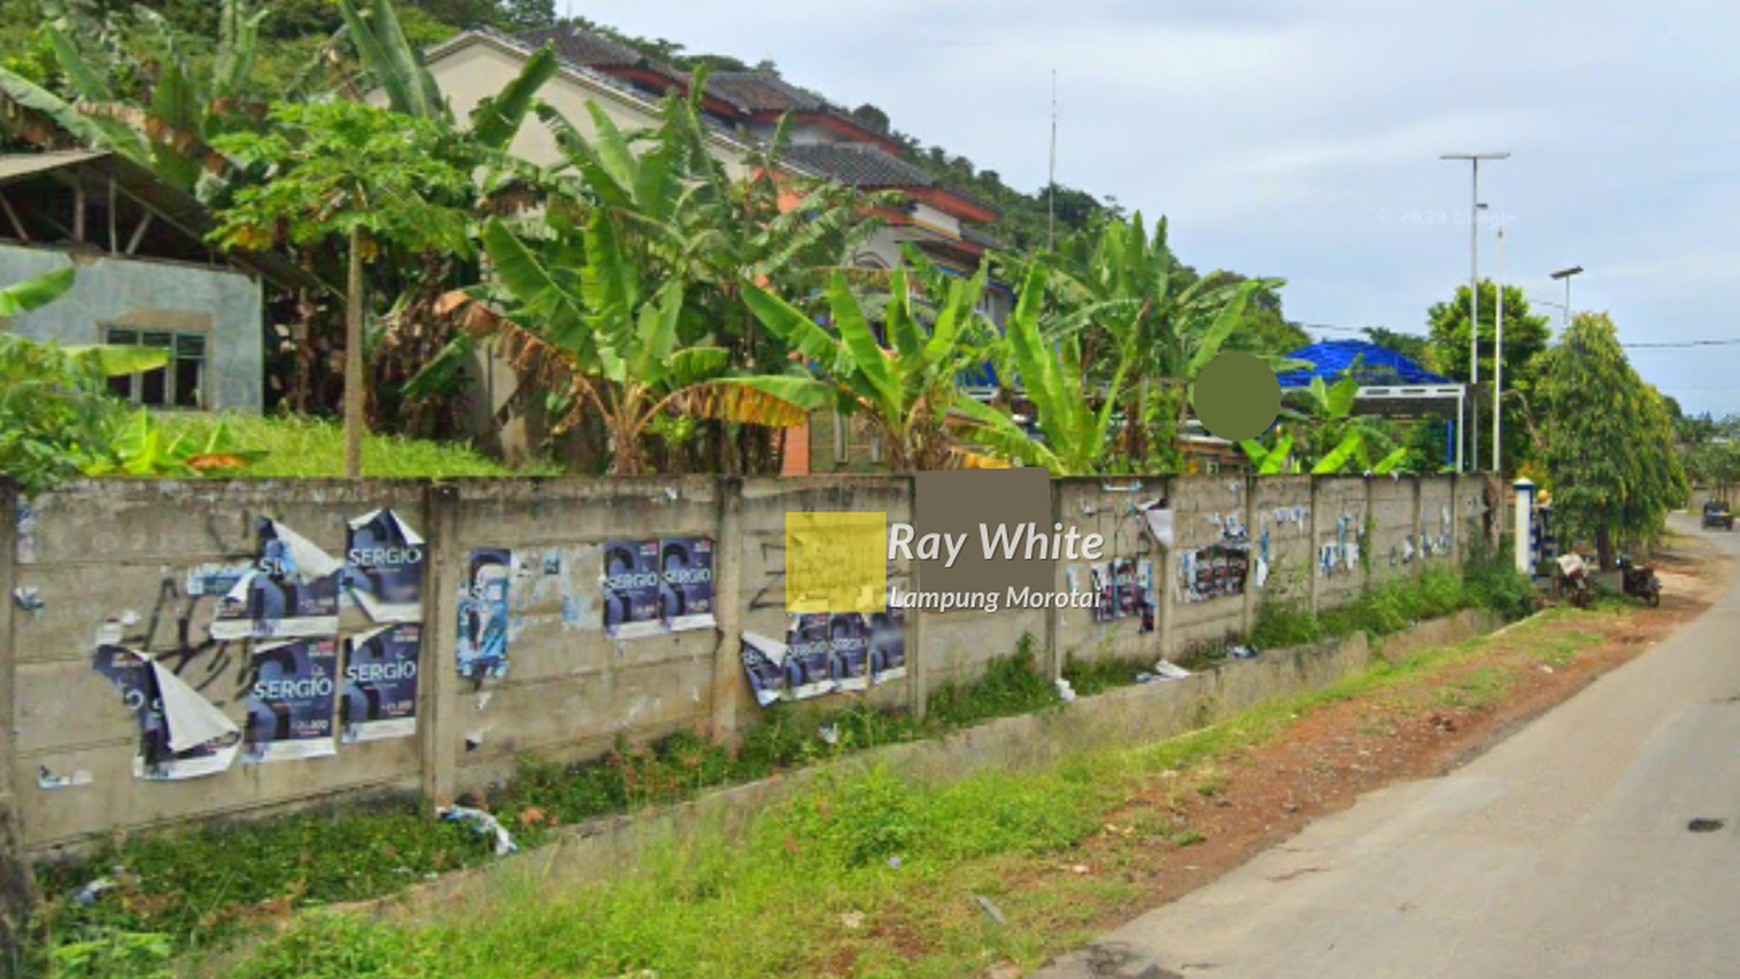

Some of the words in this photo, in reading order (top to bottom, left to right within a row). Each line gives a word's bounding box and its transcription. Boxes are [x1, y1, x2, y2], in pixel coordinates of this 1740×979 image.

[349, 547, 422, 567] SERGIO
[345, 660, 417, 682] SERGIO
[253, 677, 333, 699] SERGIO
